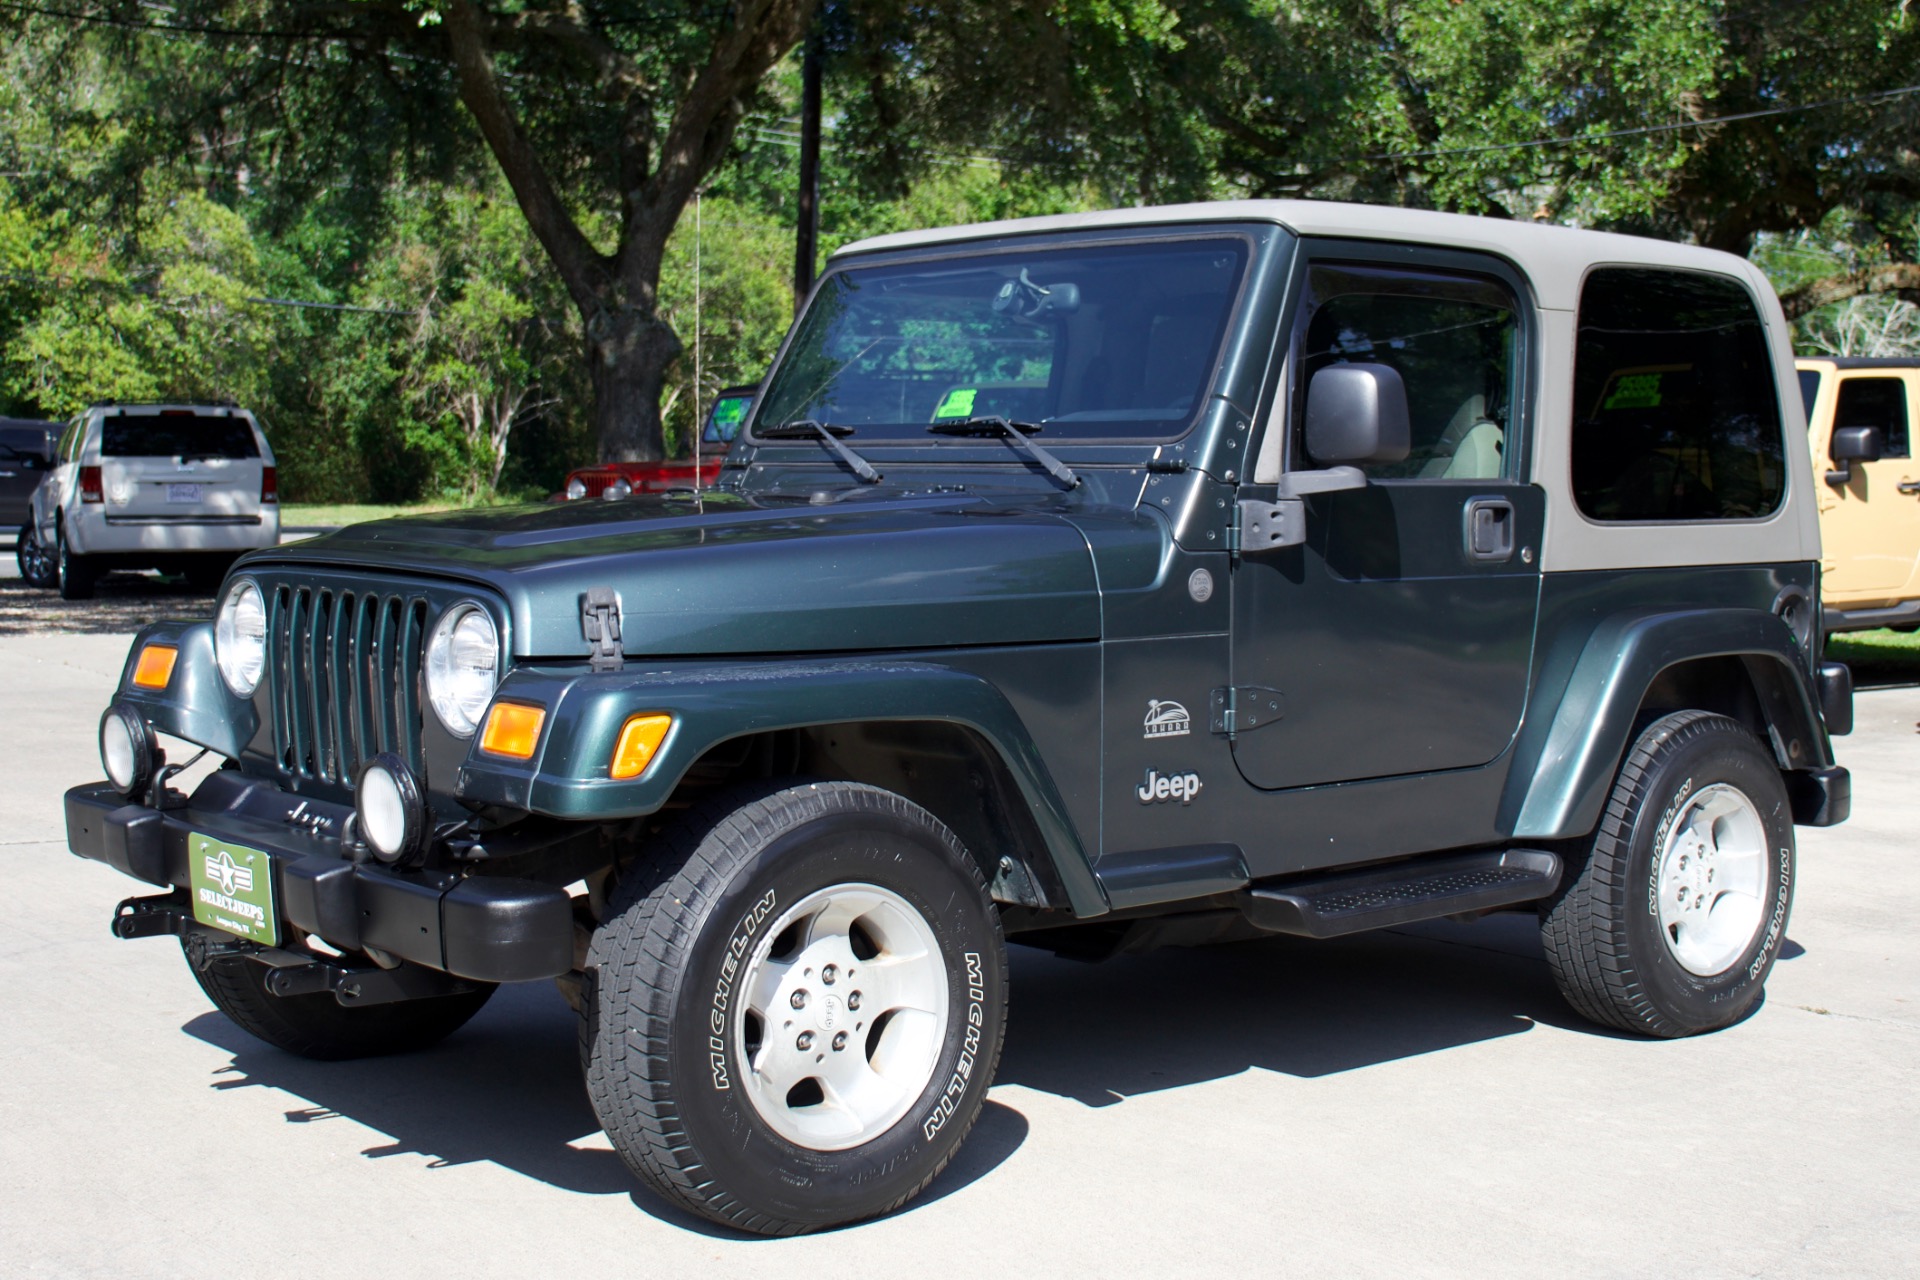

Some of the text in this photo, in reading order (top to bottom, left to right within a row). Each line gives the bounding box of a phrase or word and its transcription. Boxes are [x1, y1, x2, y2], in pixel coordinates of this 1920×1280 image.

[1138, 770, 1199, 802] Jeep
[1145, 721, 1189, 734] SAHARA
[1648, 777, 1692, 916] MICHELIN
[1749, 848, 1790, 981] MICHELIN
[708, 889, 777, 1091] MICHELIN
[922, 952, 985, 1142] MICHELIN
